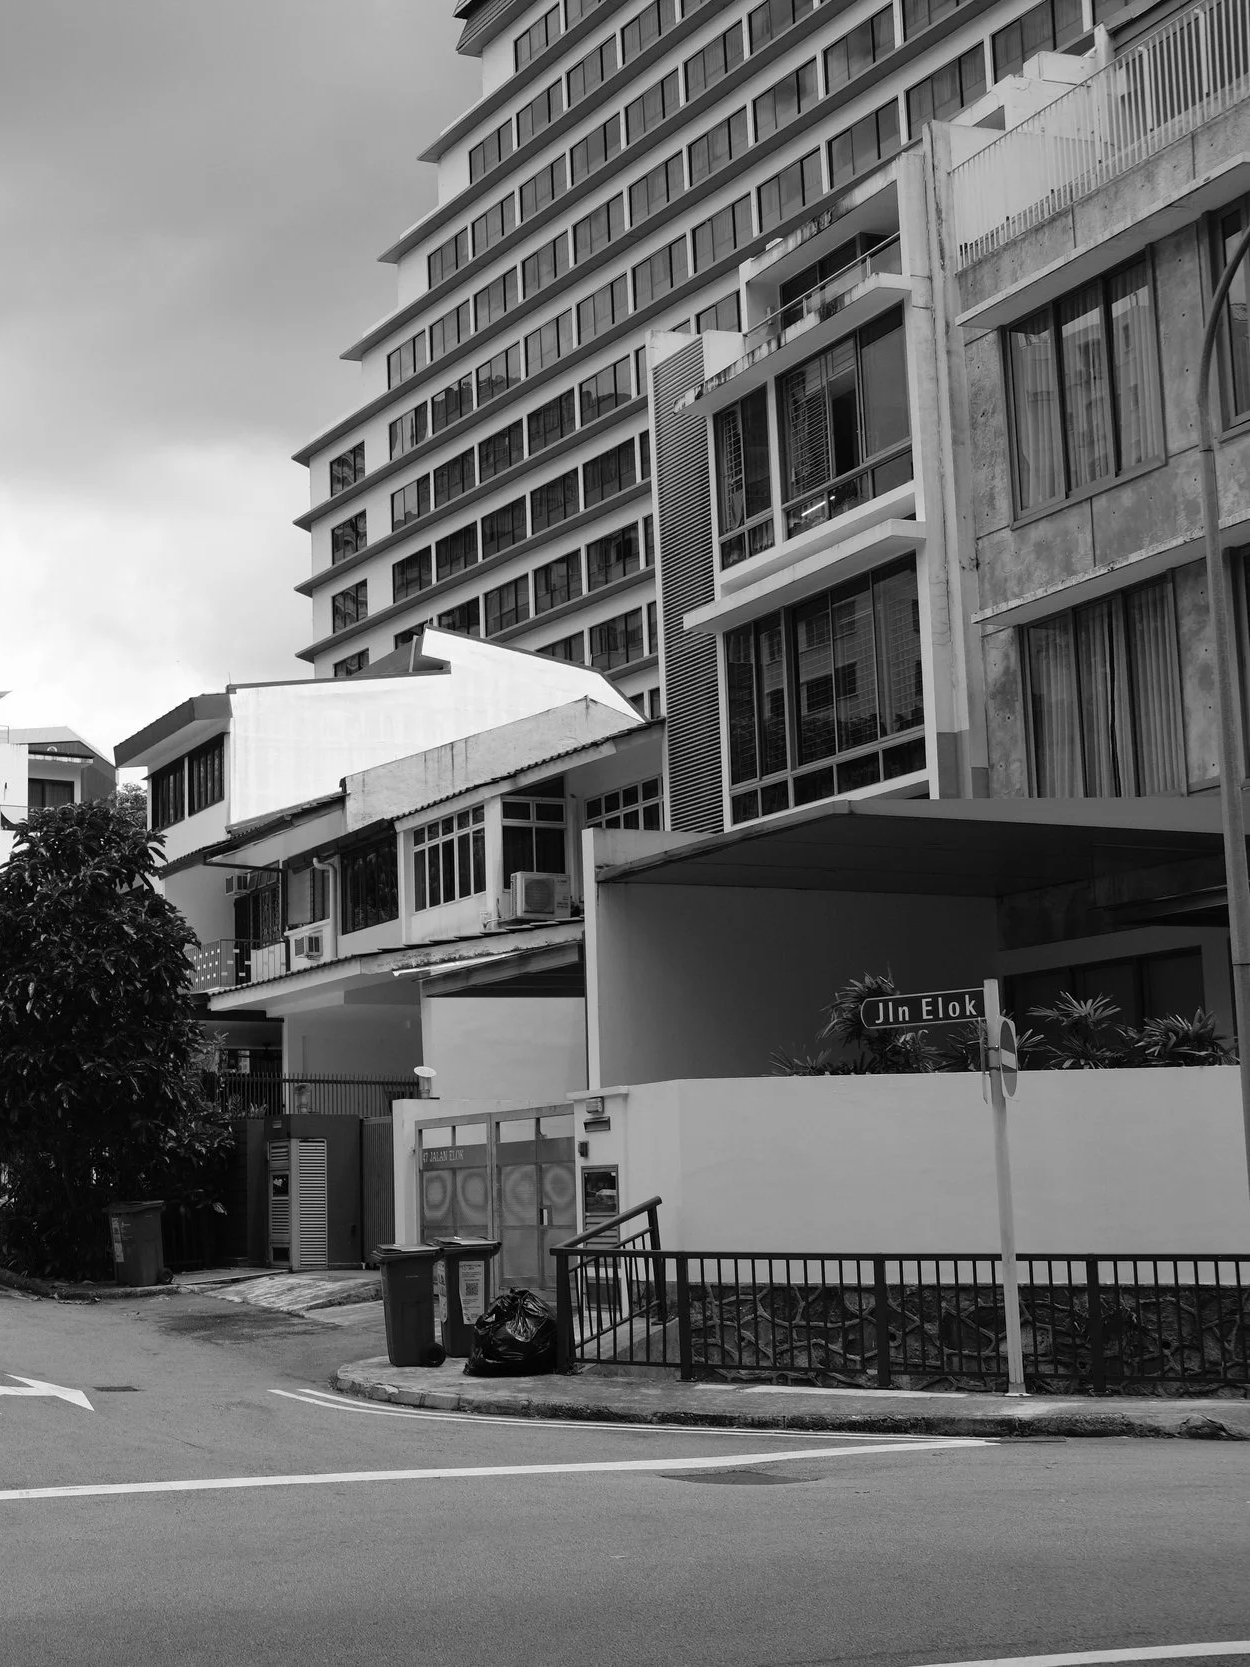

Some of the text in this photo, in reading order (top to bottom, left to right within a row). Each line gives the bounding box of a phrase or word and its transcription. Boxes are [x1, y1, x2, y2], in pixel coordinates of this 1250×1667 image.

[875, 994, 978, 1024] Jln Elok
[430, 1151, 448, 1163] JALAN
[449, 1149, 464, 1161] ELOK
